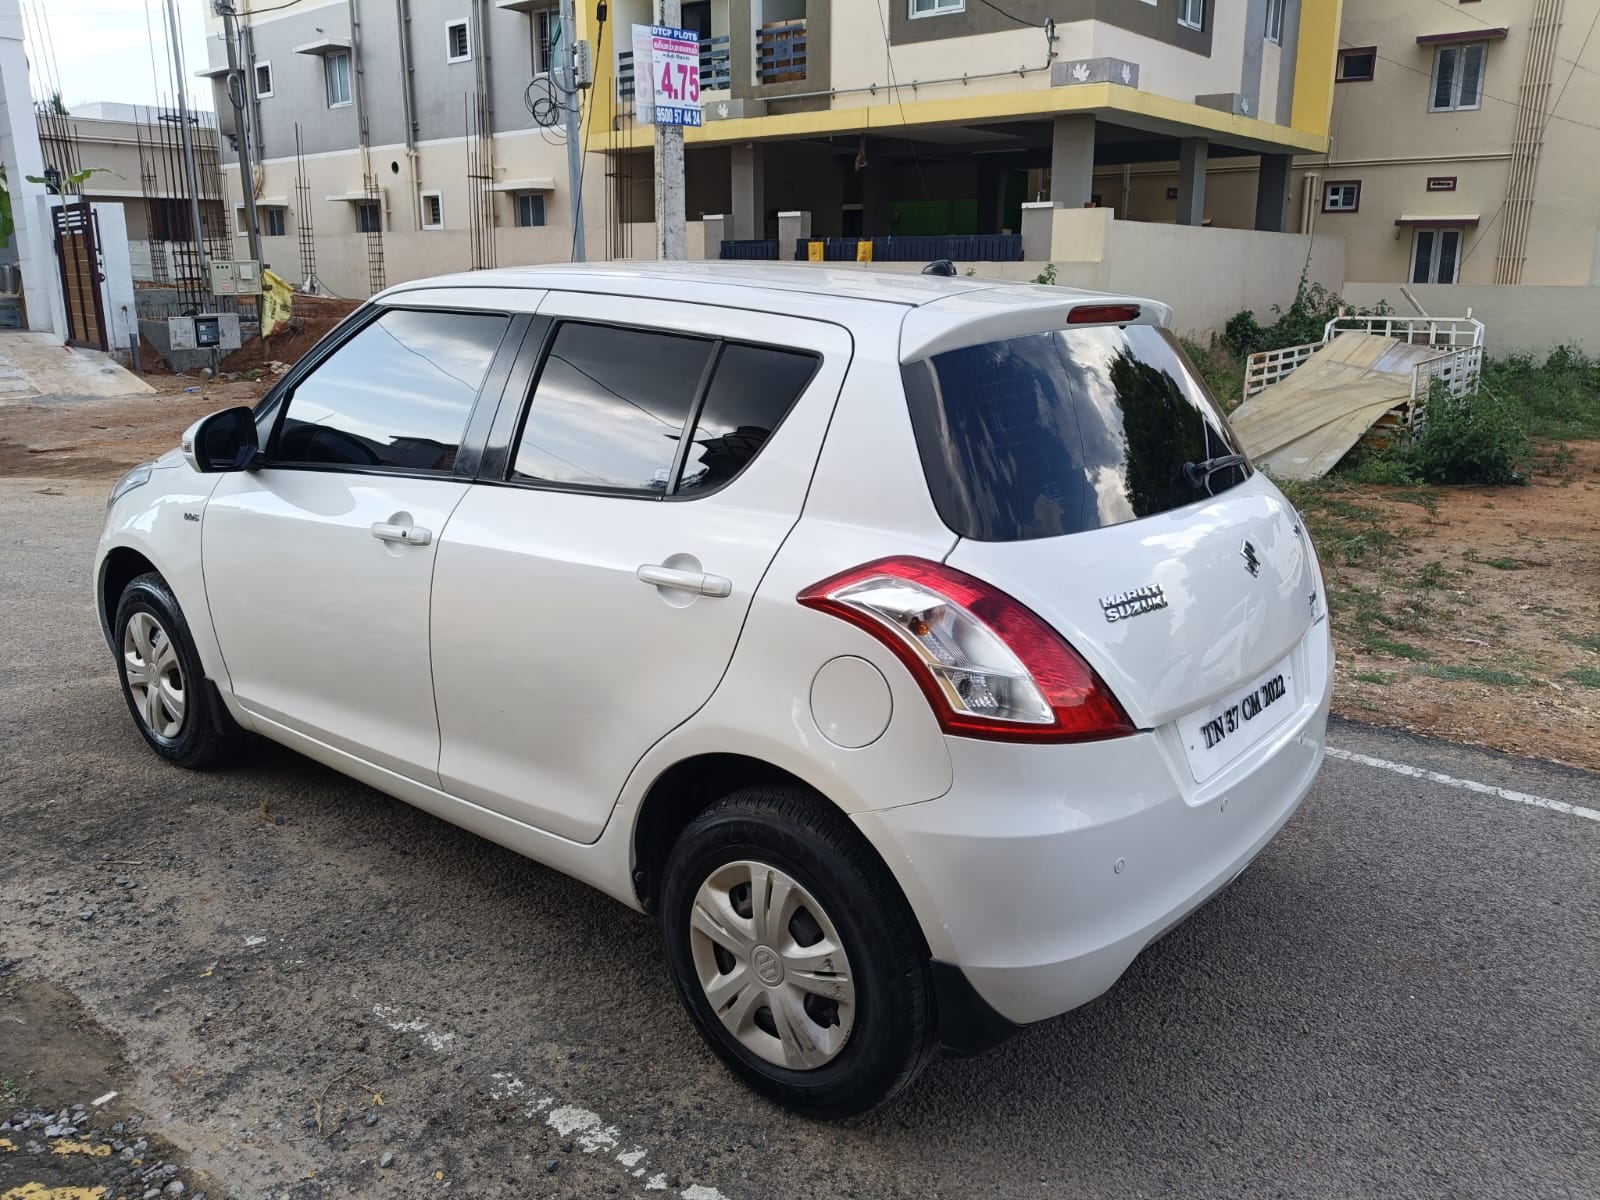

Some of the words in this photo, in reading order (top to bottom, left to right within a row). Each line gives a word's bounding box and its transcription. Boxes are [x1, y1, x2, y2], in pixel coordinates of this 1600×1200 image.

[652, 26, 672, 37] DTCP
[673, 30, 698, 41] PLOTS
[661, 62, 699, 102] 4.75
[656, 107, 673, 123] 9500
[674, 109, 682, 124] 57
[683, 110, 692, 125] 44
[692, 111, 701, 126] 24
[1099, 583, 1163, 609] MARUTI
[1105, 595, 1168, 623] SUZUKI
[1200, 715, 1226, 749] TN
[1225, 704, 1239, 733] 37
[1241, 690, 1263, 721] CM
[1261, 674, 1286, 708] 2022
